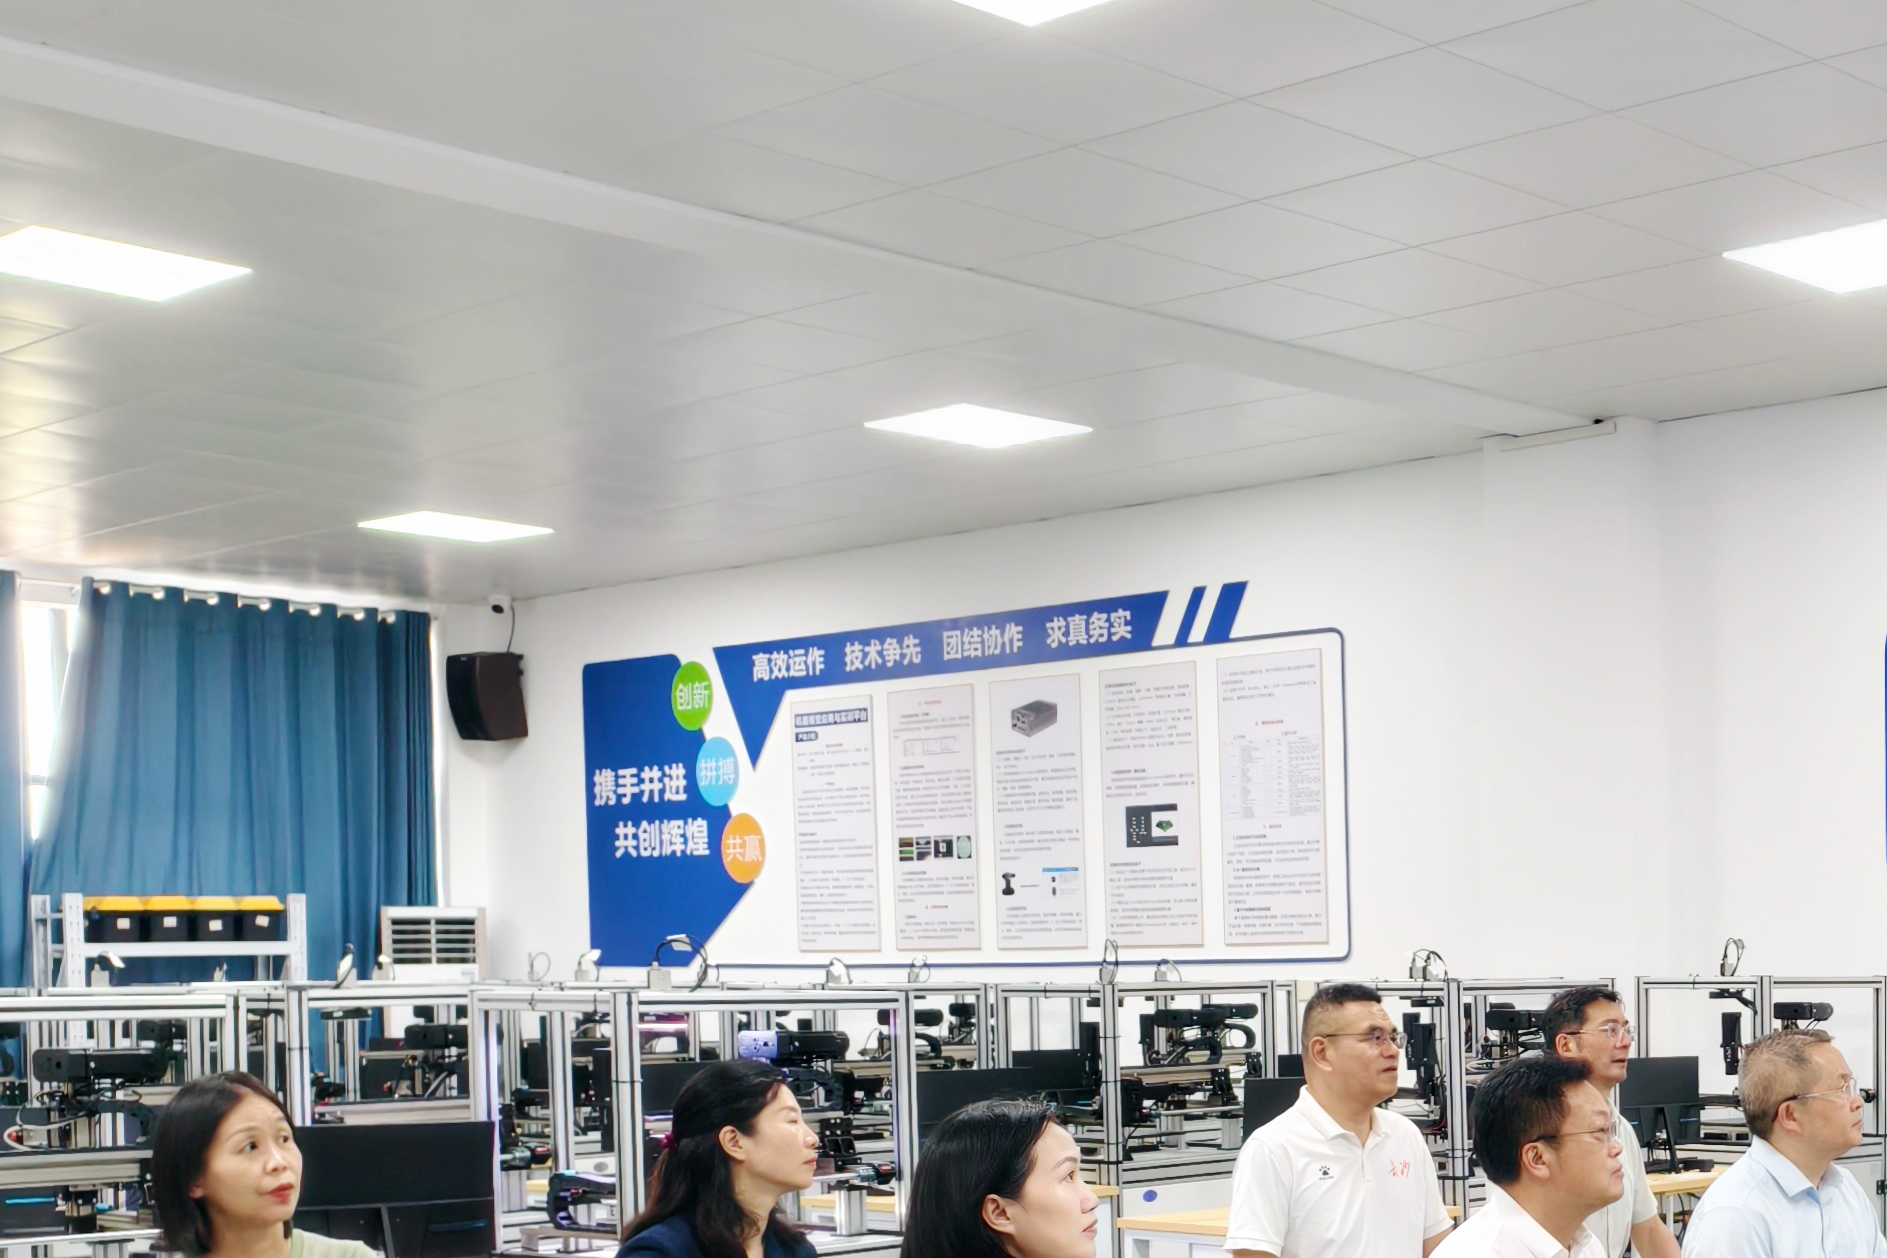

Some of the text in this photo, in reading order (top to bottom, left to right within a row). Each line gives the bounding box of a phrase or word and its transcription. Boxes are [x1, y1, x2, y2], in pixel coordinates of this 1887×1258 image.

[752, 608, 1132, 682] 高效运作 技术争先 团结协作 求真务实
[675, 681, 711, 711] 创新
[593, 763, 687, 806] 携手并进
[699, 757, 736, 787] 拼搏
[614, 817, 710, 858] 共创辉煌
[726, 834, 763, 863] 共赢
